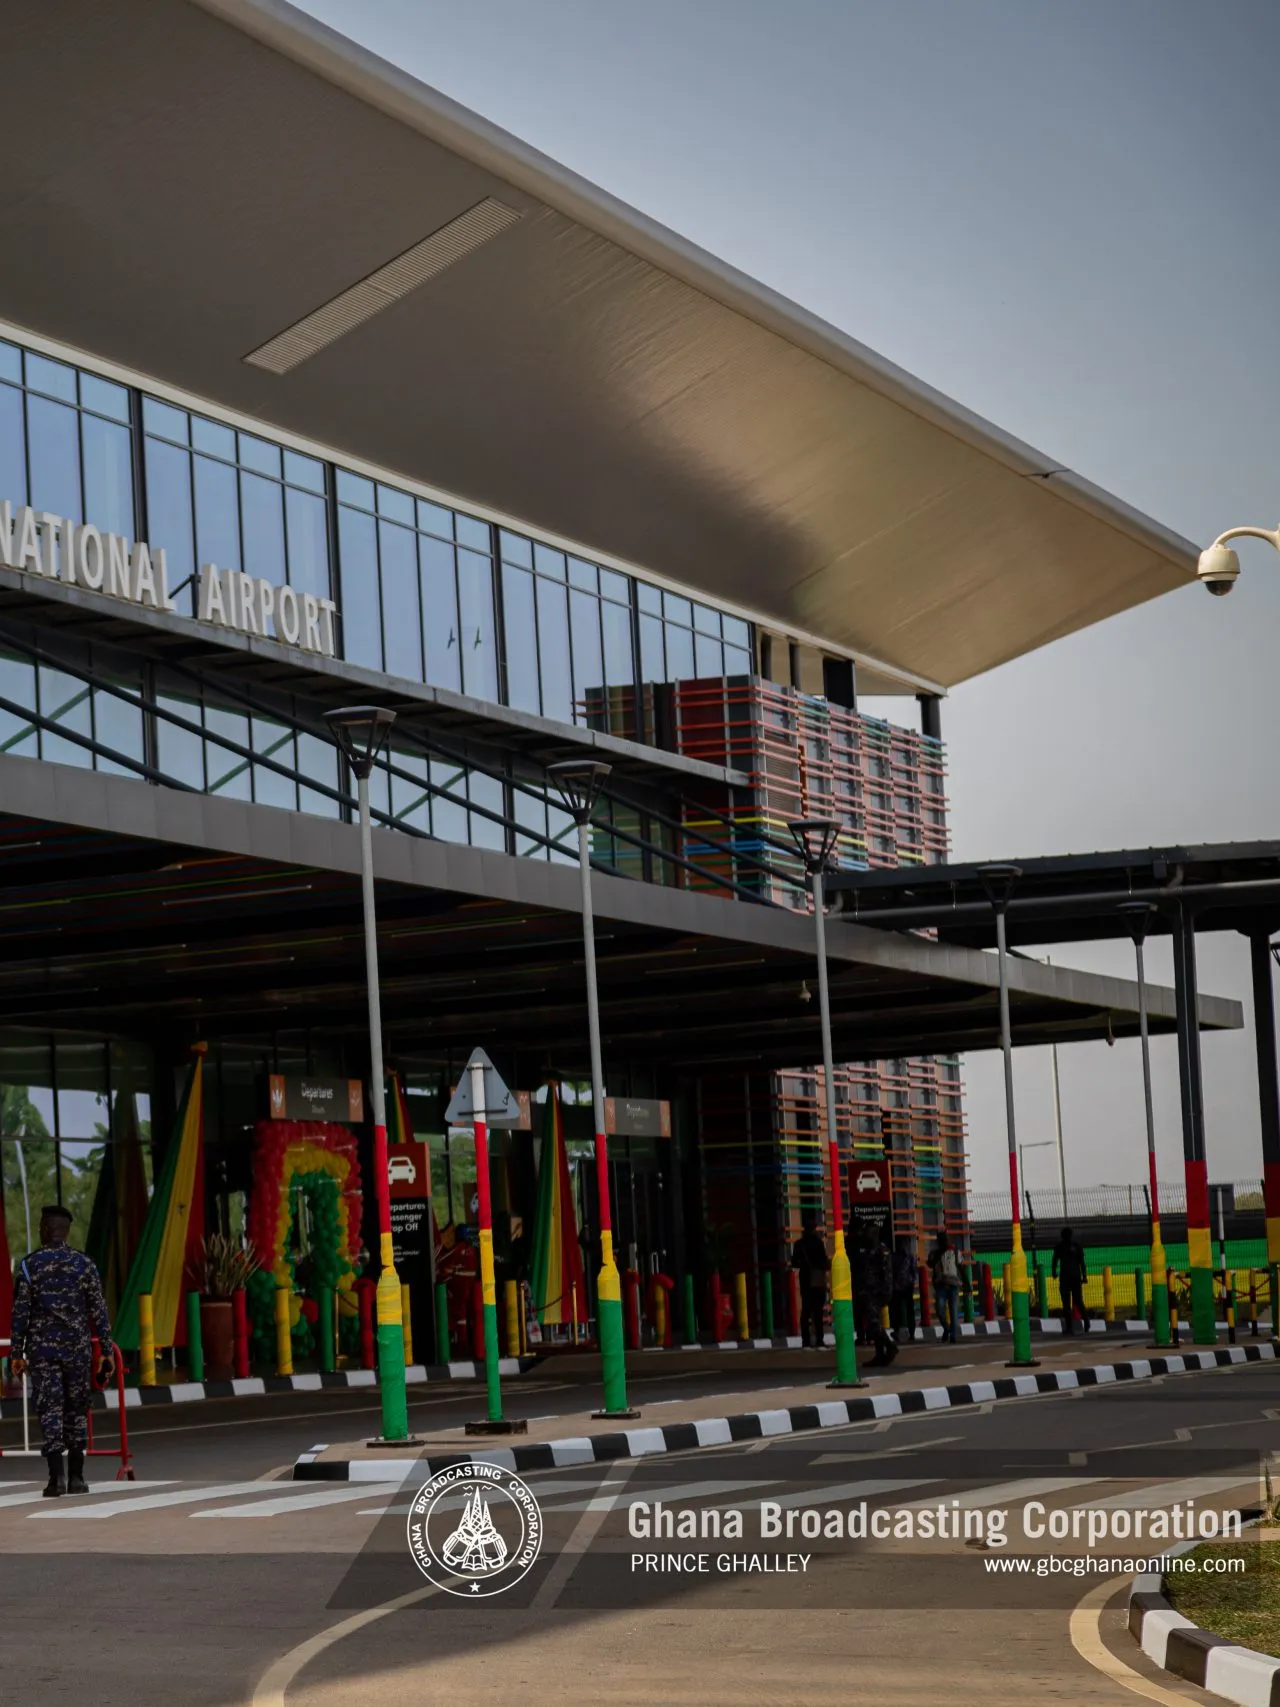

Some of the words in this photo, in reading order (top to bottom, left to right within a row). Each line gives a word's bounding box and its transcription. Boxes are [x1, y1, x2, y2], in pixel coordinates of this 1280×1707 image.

[197, 563, 337, 656] AIRPORT
[390, 1203, 426, 1212] epartures
[405, 1223, 419, 1231] Off
